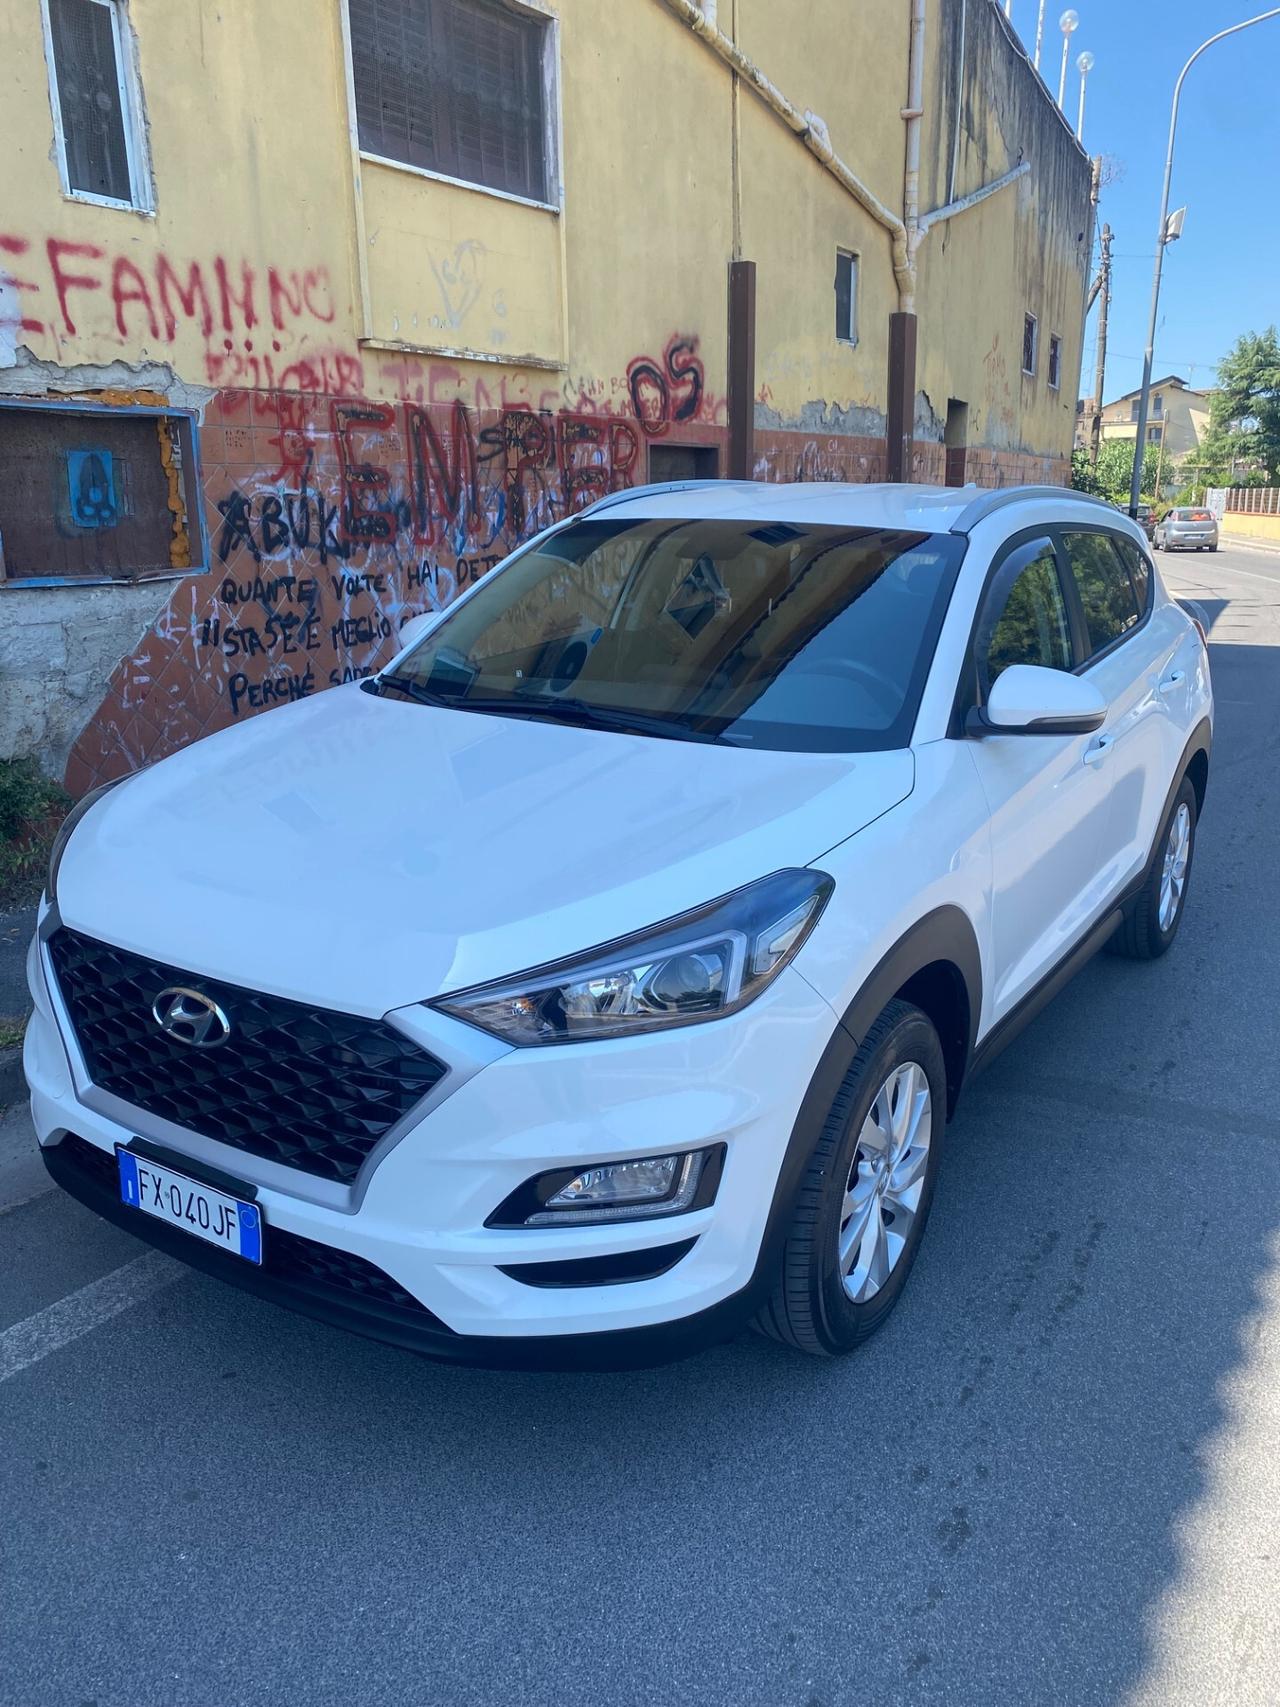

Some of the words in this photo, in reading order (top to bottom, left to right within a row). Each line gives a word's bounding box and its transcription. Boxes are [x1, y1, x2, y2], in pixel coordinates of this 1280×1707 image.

[220, 574, 314, 605] QUANTE
[331, 573, 387, 600] VOLTE
[407, 555, 439, 590] HAI
[331, 610, 391, 651] MEGLIO
